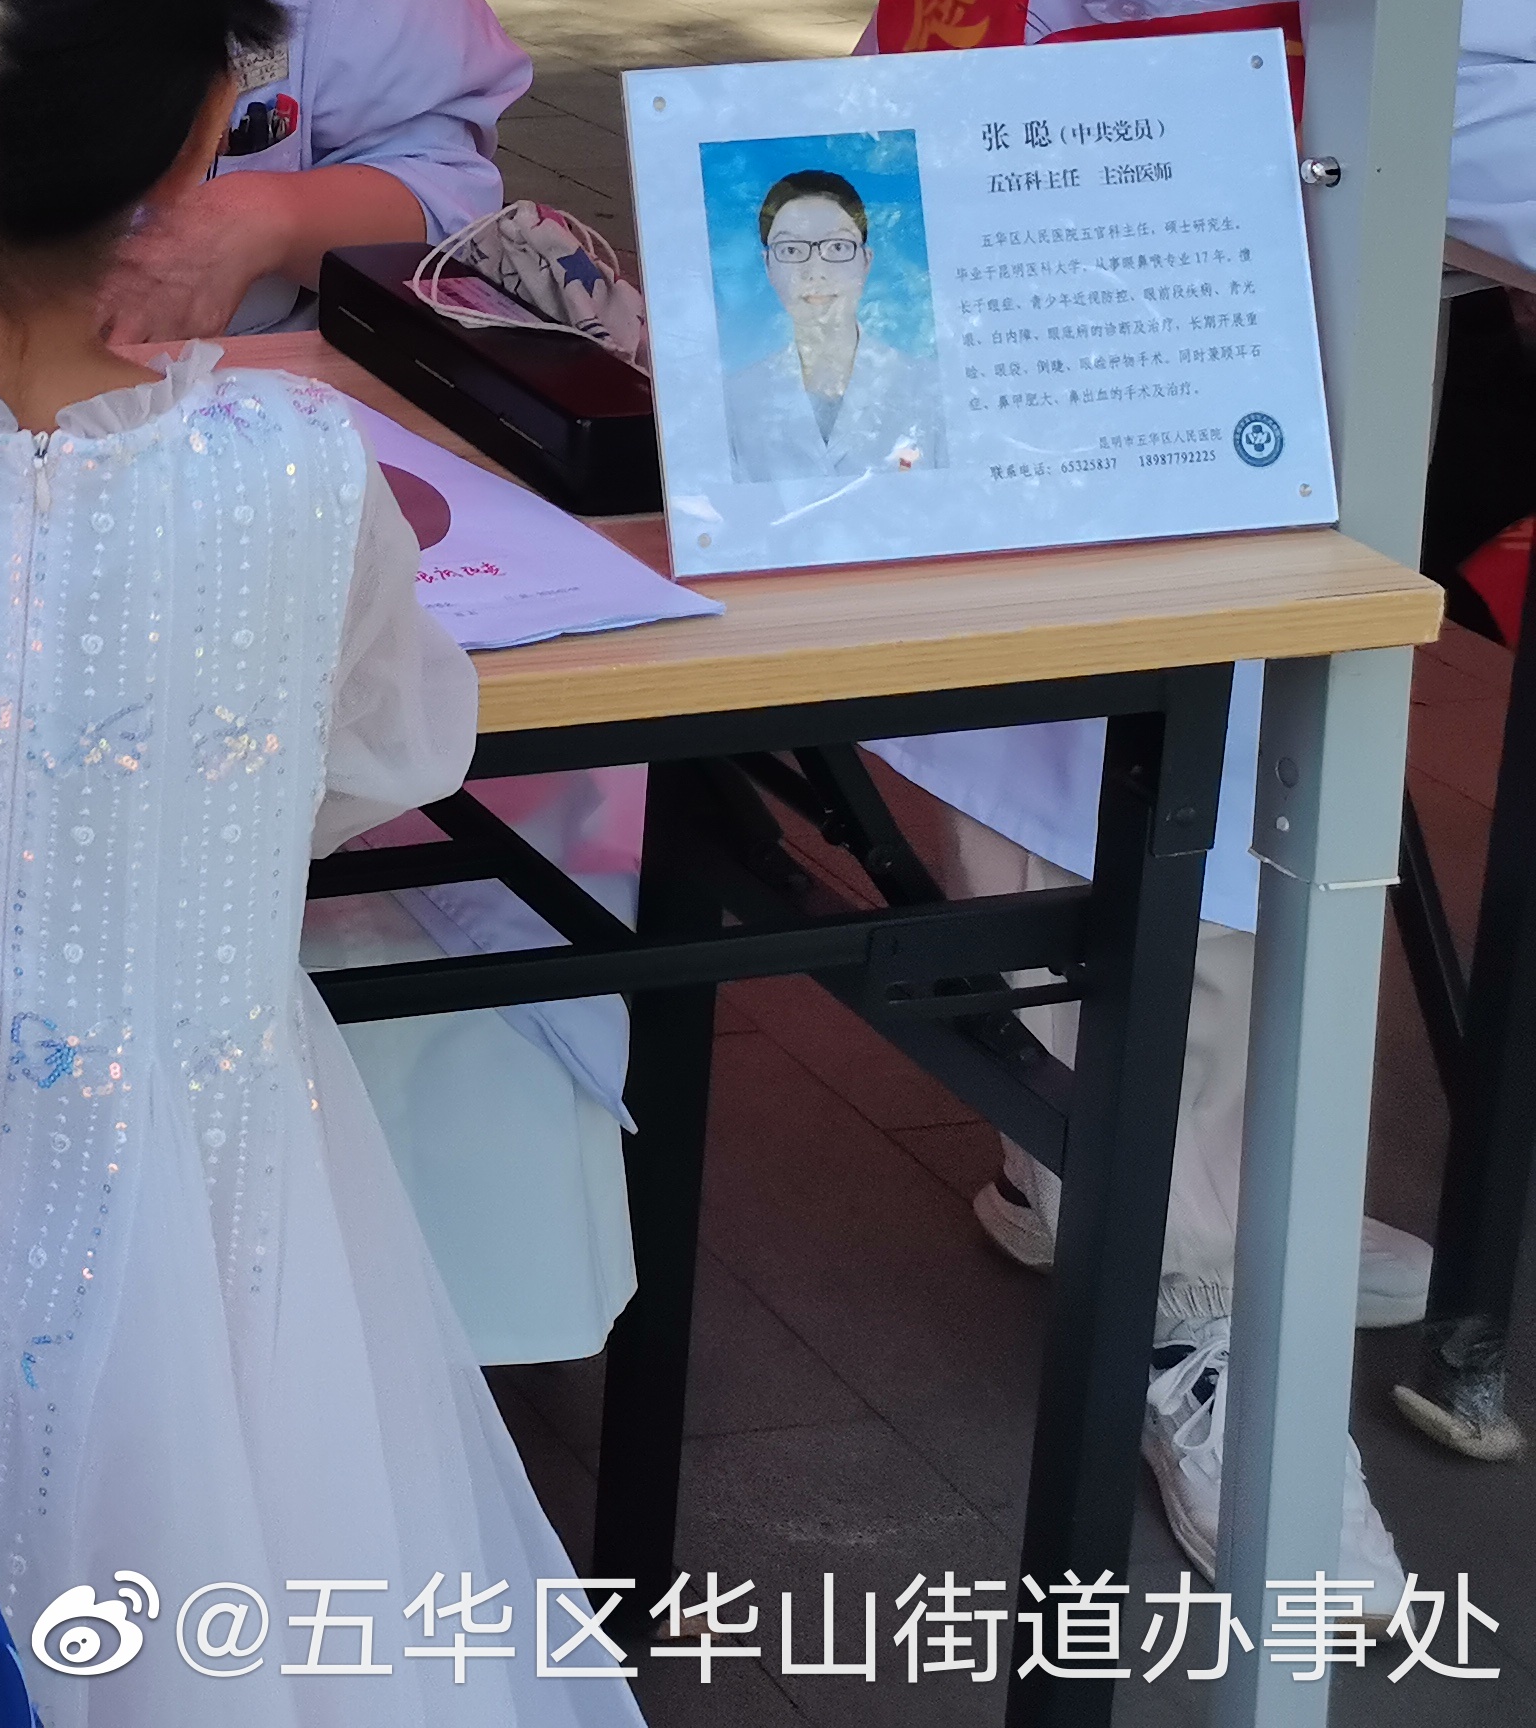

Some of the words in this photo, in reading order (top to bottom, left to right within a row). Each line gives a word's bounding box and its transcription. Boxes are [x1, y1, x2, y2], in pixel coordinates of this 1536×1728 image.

[986, 168, 1080, 194] 五官科主任
[1099, 161, 1173, 186] 主治医师
[1098, 427, 1223, 451] 昆明市五华区人民医院
[1060, 457, 1117, 475] 65325837
[1138, 449, 1217, 468] 18987792225
